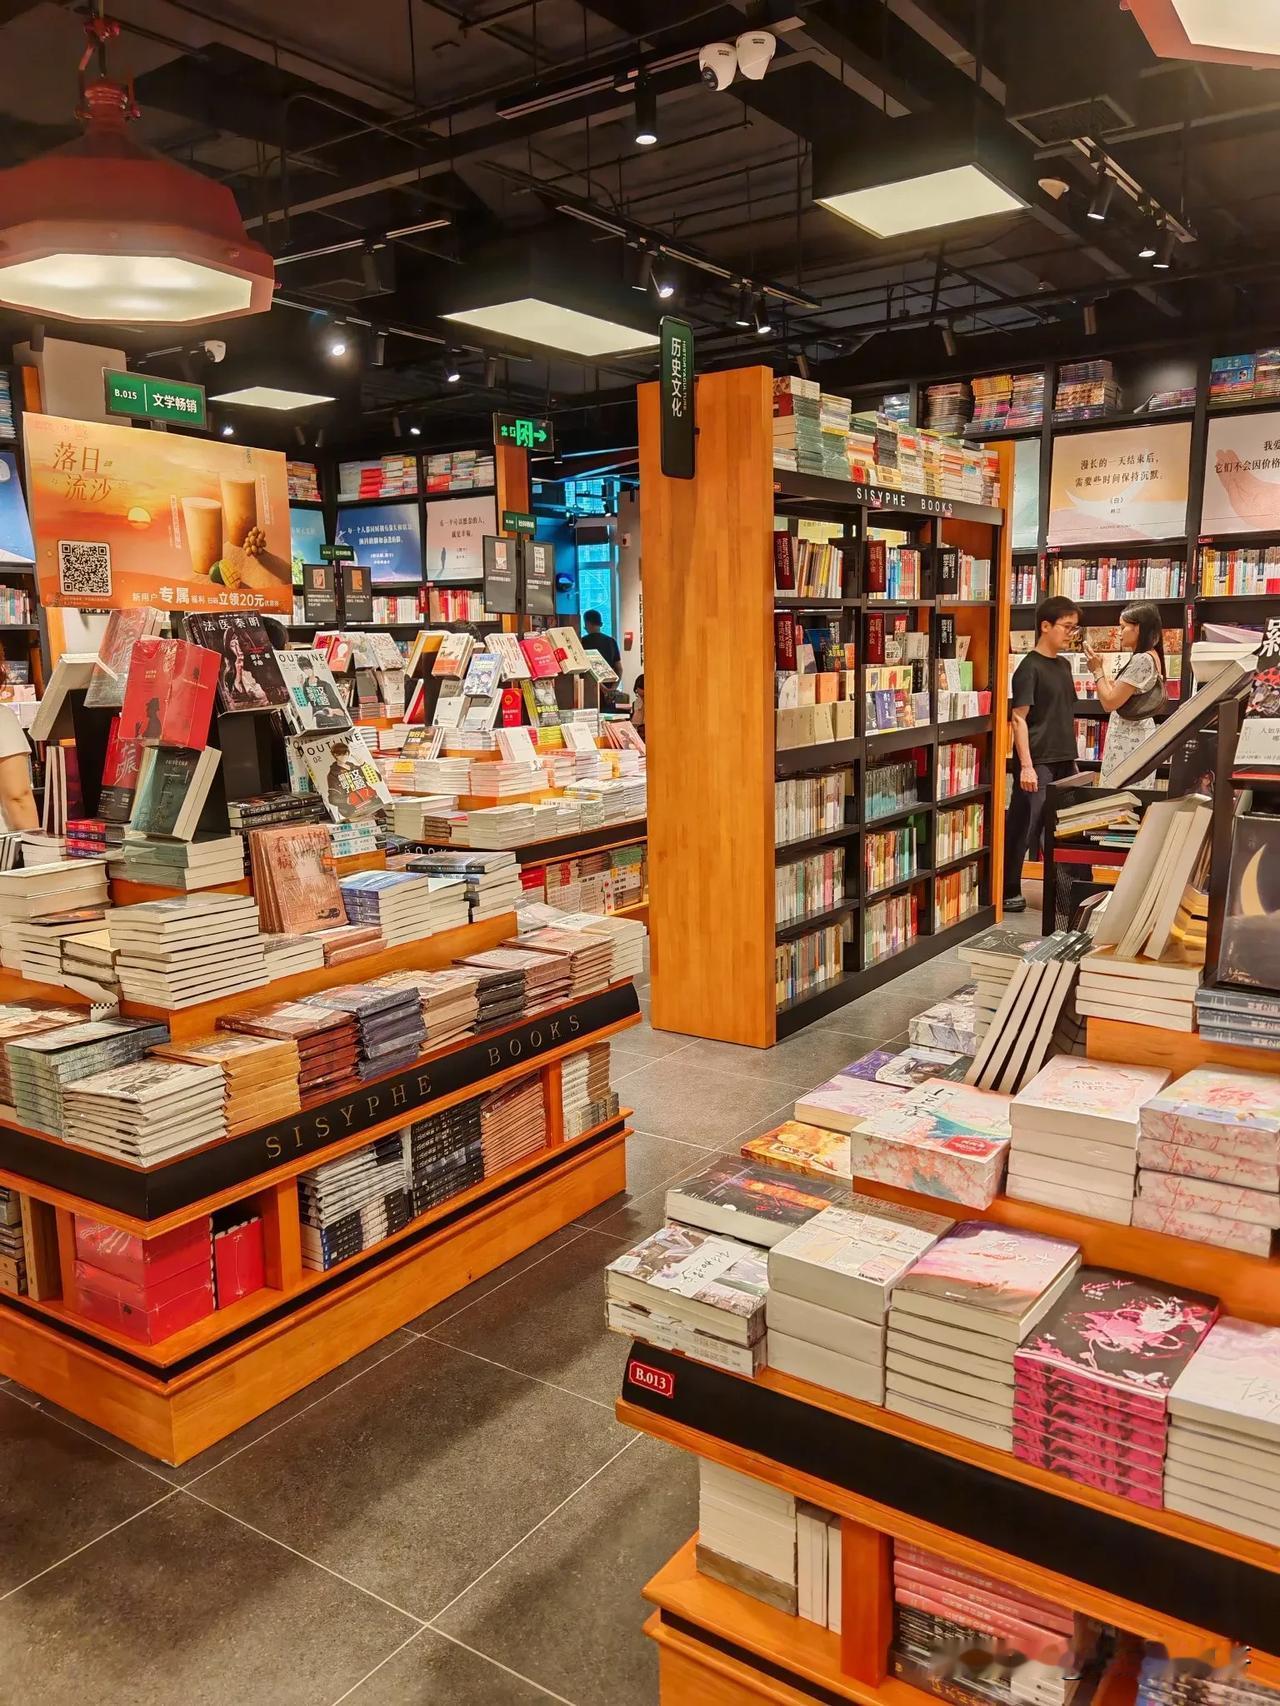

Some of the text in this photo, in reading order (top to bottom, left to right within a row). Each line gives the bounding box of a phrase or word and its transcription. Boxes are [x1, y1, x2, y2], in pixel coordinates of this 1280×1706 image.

[671, 337, 682, 418] 历史文化
[114, 388, 197, 413] B.015 文学畅销
[501, 425, 516, 437] 出口
[52, 441, 99, 473] 落日
[65, 472, 112, 503] 流沙
[856, 487, 906, 507] SISYPHE
[921, 498, 953, 513] BOOKS
[202, 617, 260, 632] 法医秦明
[278, 653, 325, 663] OUTINE
[306, 733, 361, 756] OUTINE
[265, 1074, 432, 1160] SISYPHE
[488, 1014, 582, 1067] BOOKS
[635, 1367, 667, 1390] B.013
